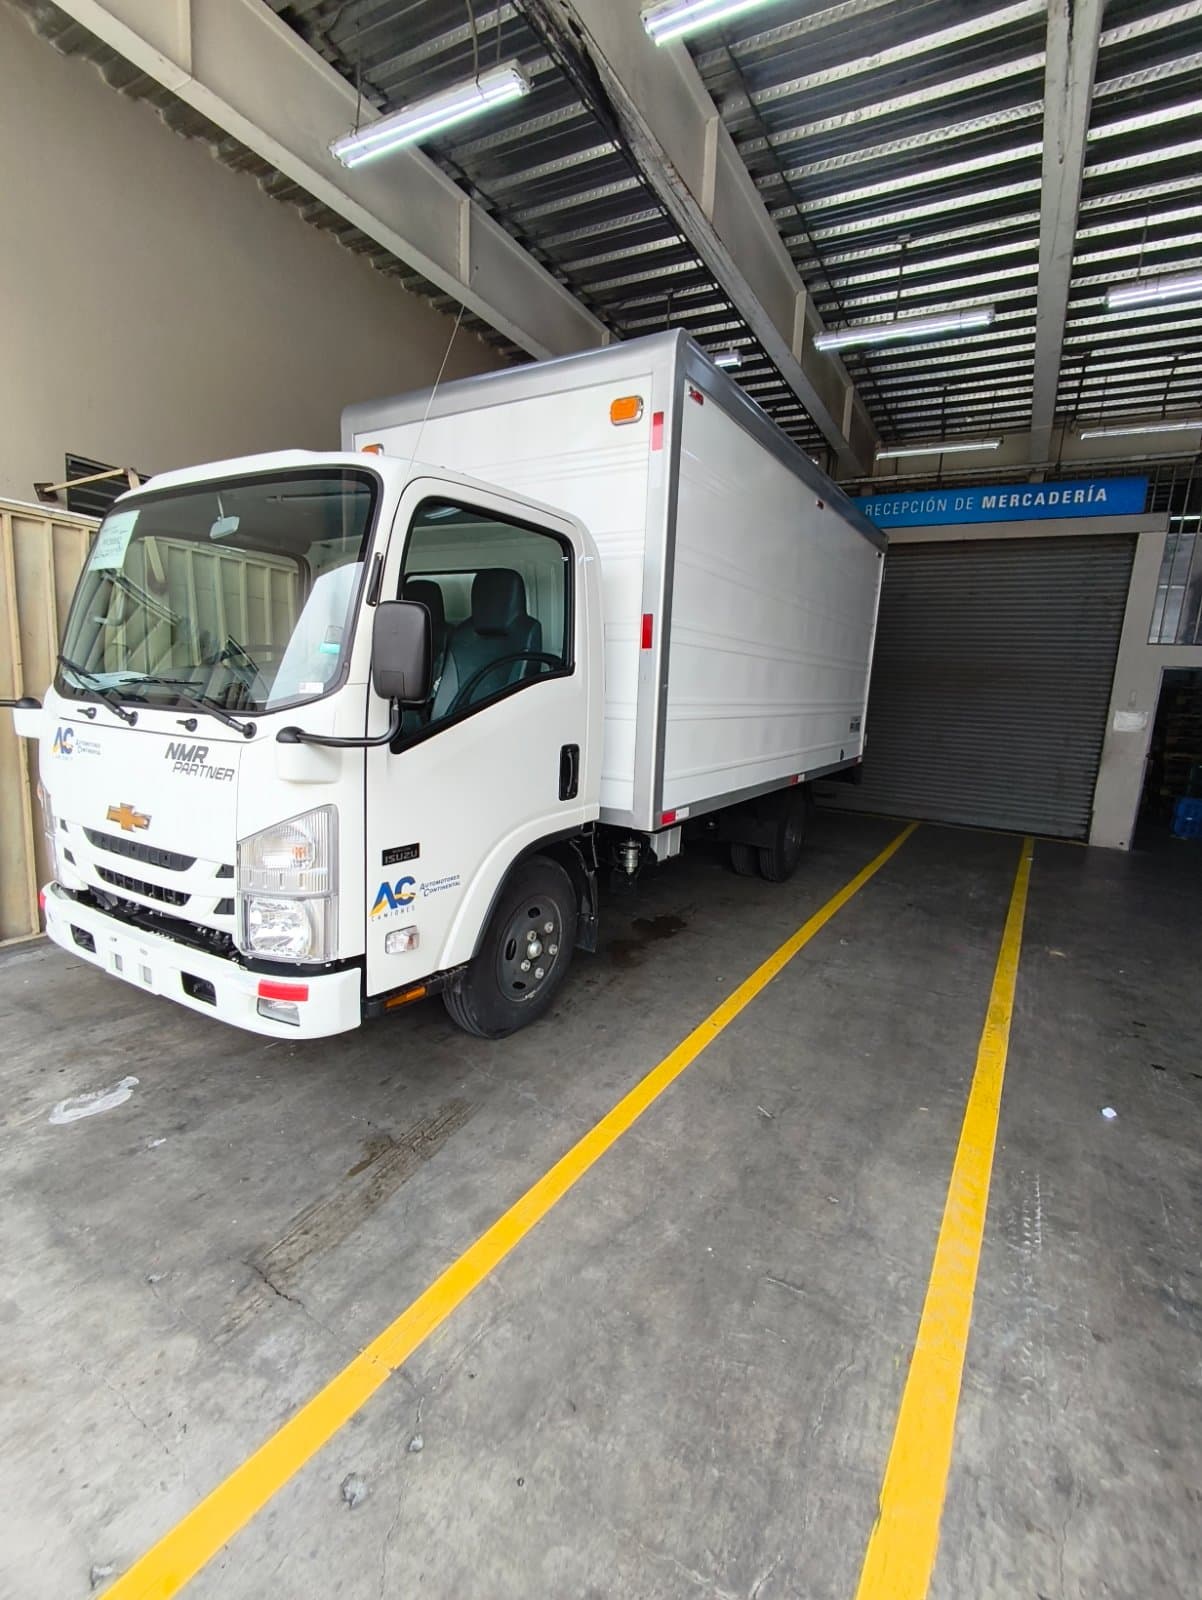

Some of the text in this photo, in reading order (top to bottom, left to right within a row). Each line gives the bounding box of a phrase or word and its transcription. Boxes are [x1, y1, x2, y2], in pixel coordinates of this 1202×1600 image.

[865, 485, 1108, 517] RECEPCIÓN DE MERCADERÍA
[165, 742, 209, 764] NMR
[172, 762, 235, 782] PARTNER
[385, 850, 418, 864] ISUZU
[369, 876, 417, 917] AC
